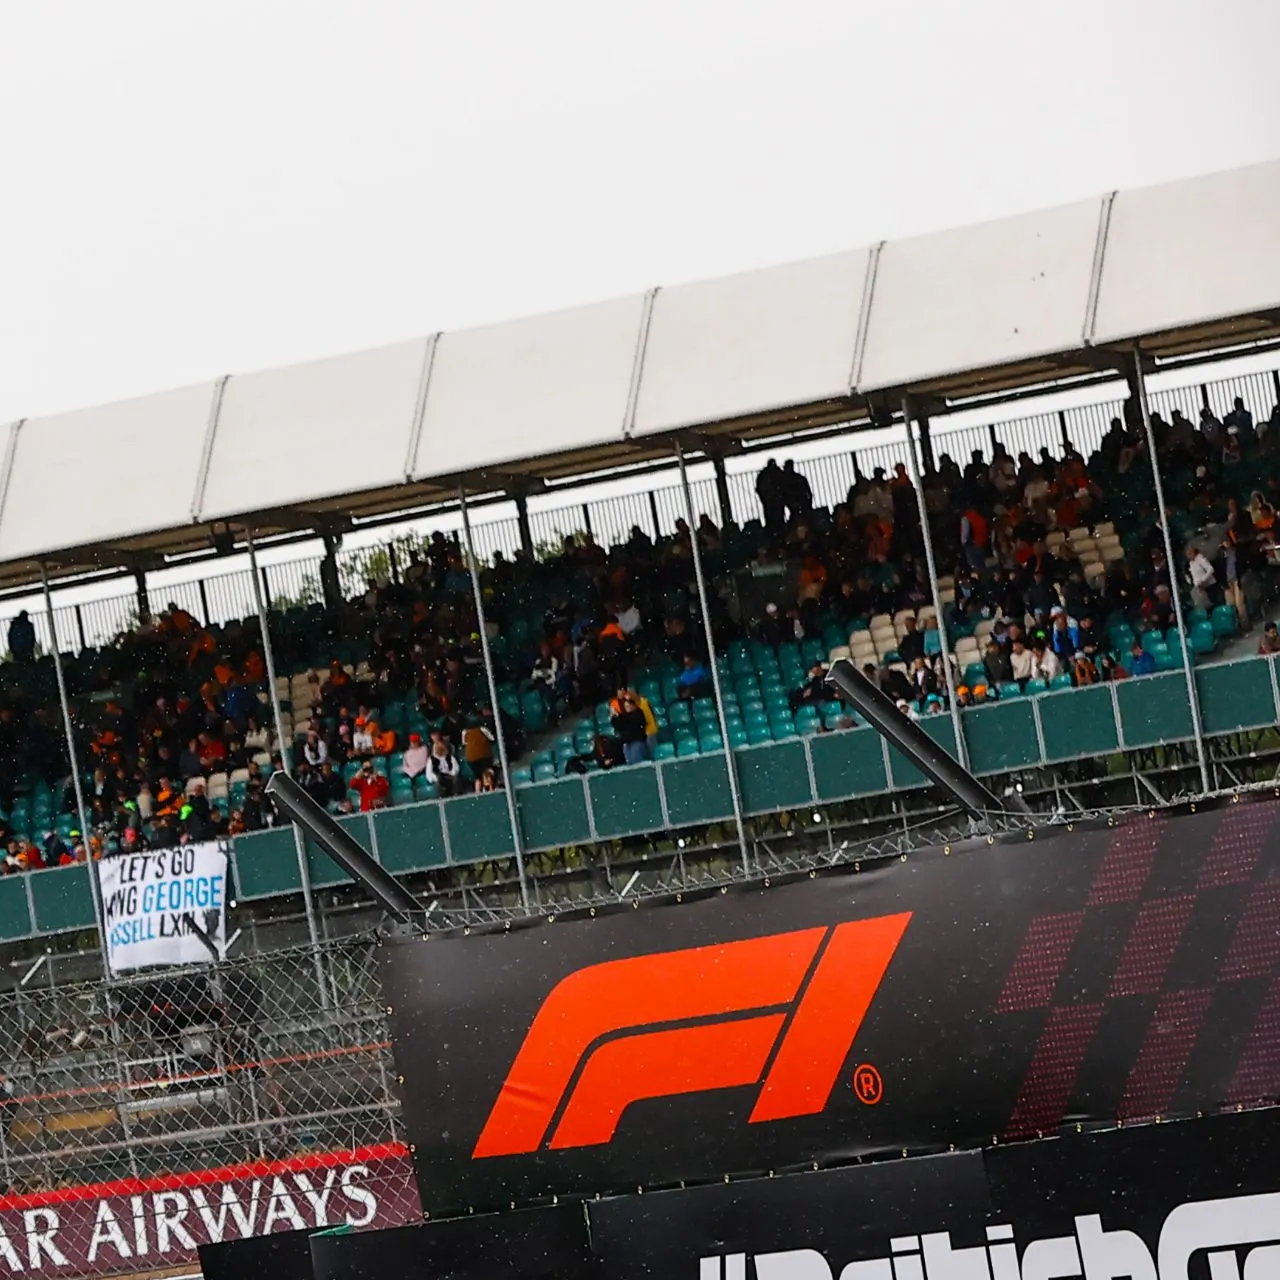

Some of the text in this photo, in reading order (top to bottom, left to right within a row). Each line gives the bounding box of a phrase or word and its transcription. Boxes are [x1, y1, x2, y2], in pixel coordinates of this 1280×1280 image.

[120, 849, 195, 884] LET'S GO
[142, 875, 223, 913] GEORGE
[472, 911, 913, 1159] F1
[87, 1165, 377, 1262] AIRWAYS
